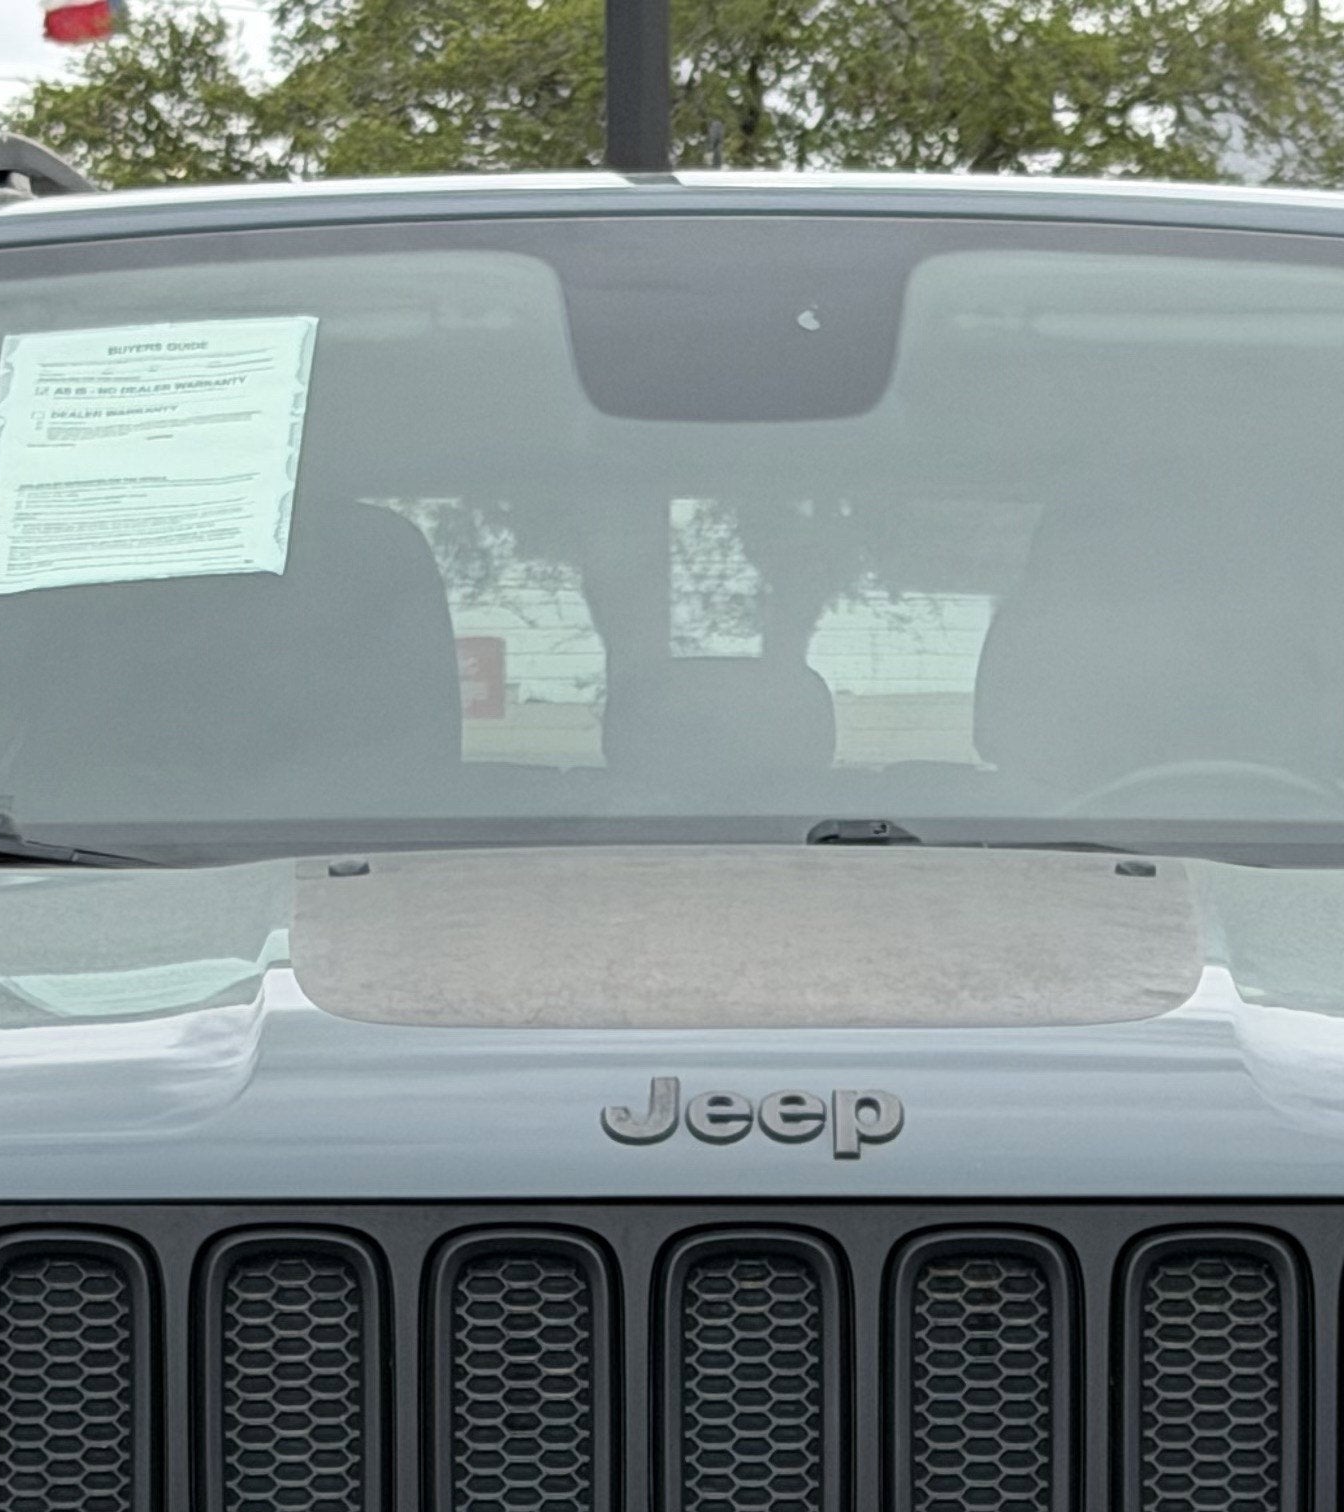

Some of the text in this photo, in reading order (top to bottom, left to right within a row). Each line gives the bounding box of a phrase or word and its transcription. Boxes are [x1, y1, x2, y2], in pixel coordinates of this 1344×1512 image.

[107, 341, 209, 356] BUYERS GUIDE
[120, 383, 171, 395] DEALER
[174, 376, 248, 391] WARRANTY
[49, 405, 179, 419] DEALER WARRANTY
[600, 1076, 905, 1160] Jeep
